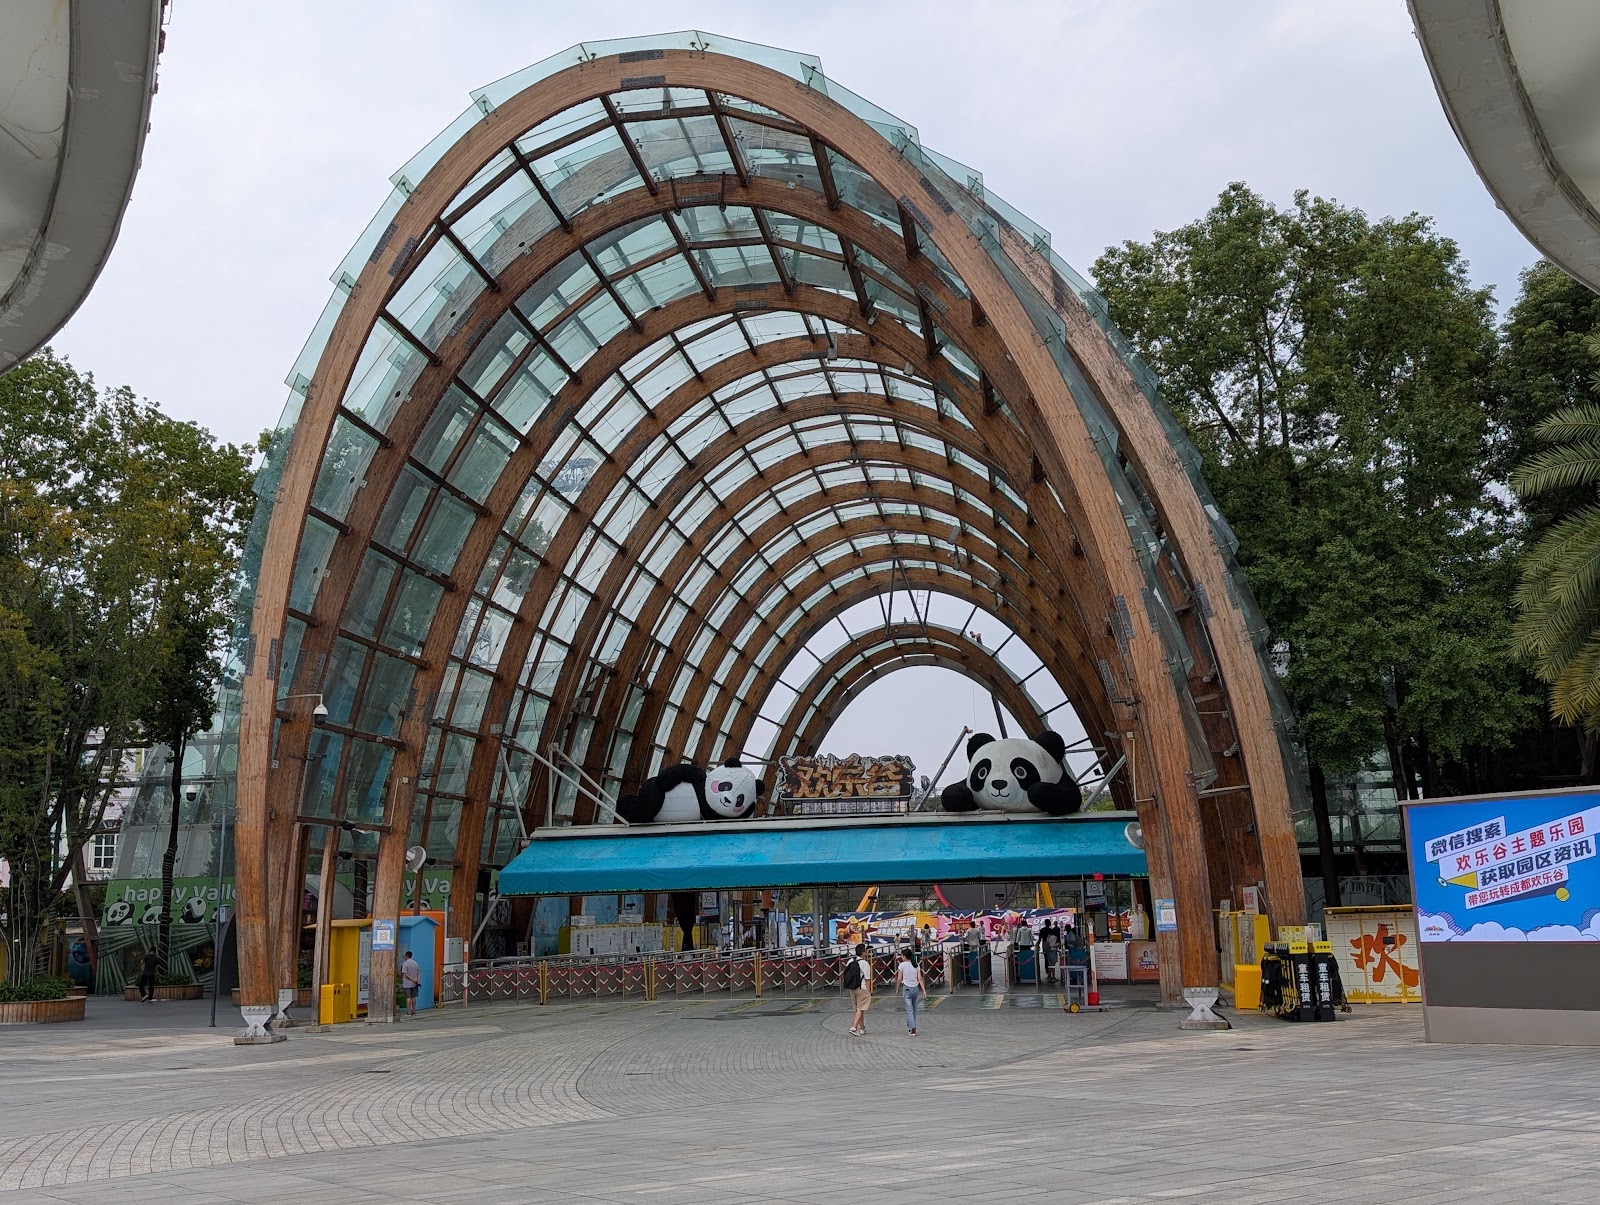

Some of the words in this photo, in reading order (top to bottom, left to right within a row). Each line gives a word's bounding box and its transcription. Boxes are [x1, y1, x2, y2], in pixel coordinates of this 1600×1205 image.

[1430, 821, 1502, 857] 微信搜索
[1456, 816, 1585, 872] 欢乐谷主题乐园
[1480, 839, 1592, 887] 获取园区资讯
[124, 885, 187, 904] hapy
[1468, 868, 1564, 906] 带您玩转成都欢乐谷
[1297, 963, 1311, 1002] 童车租赁
[1317, 962, 1331, 1002] 童车租赁
